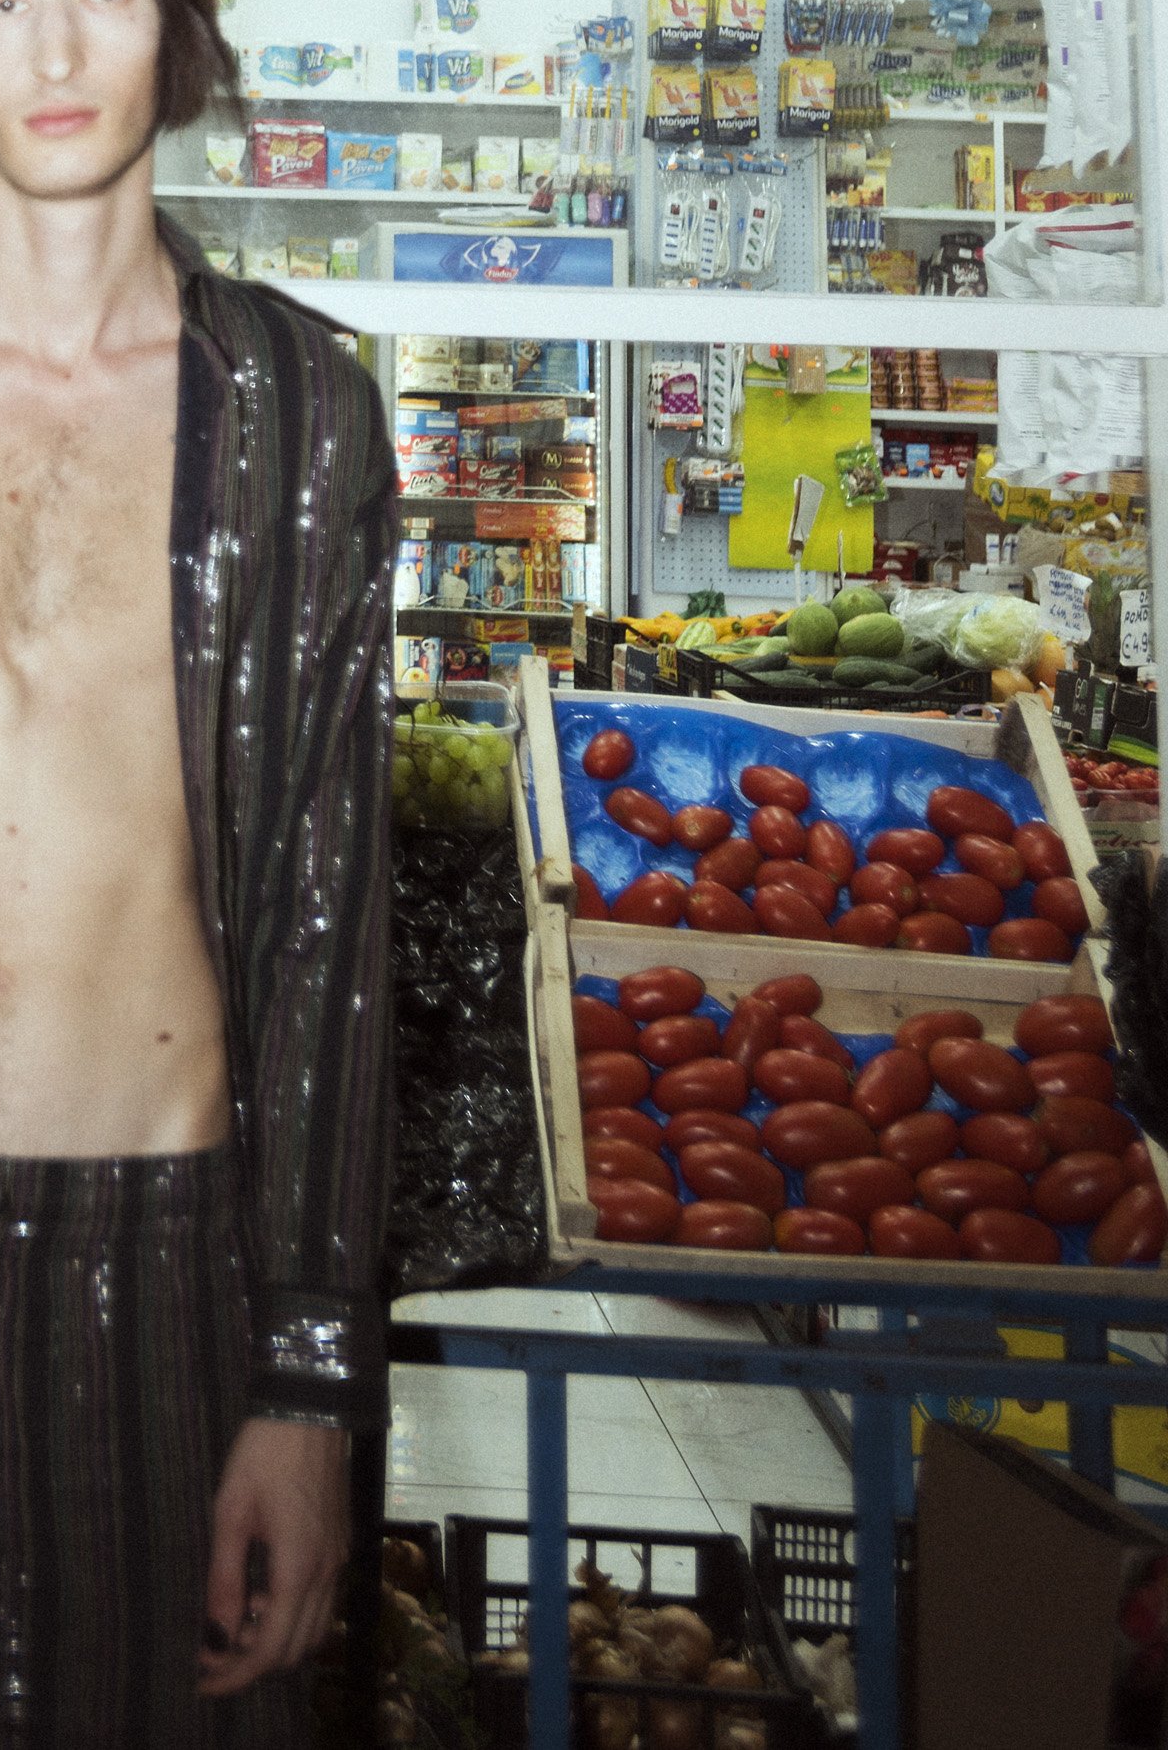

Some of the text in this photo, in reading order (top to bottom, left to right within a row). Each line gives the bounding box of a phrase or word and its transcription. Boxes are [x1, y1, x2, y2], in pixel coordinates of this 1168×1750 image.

[661, 27, 704, 41] Marigold
[718, 26, 761, 42] Marigold
[789, 106, 832, 121] Marigold
[658, 116, 700, 129] Marigold
[716, 117, 757, 130] Marigold
